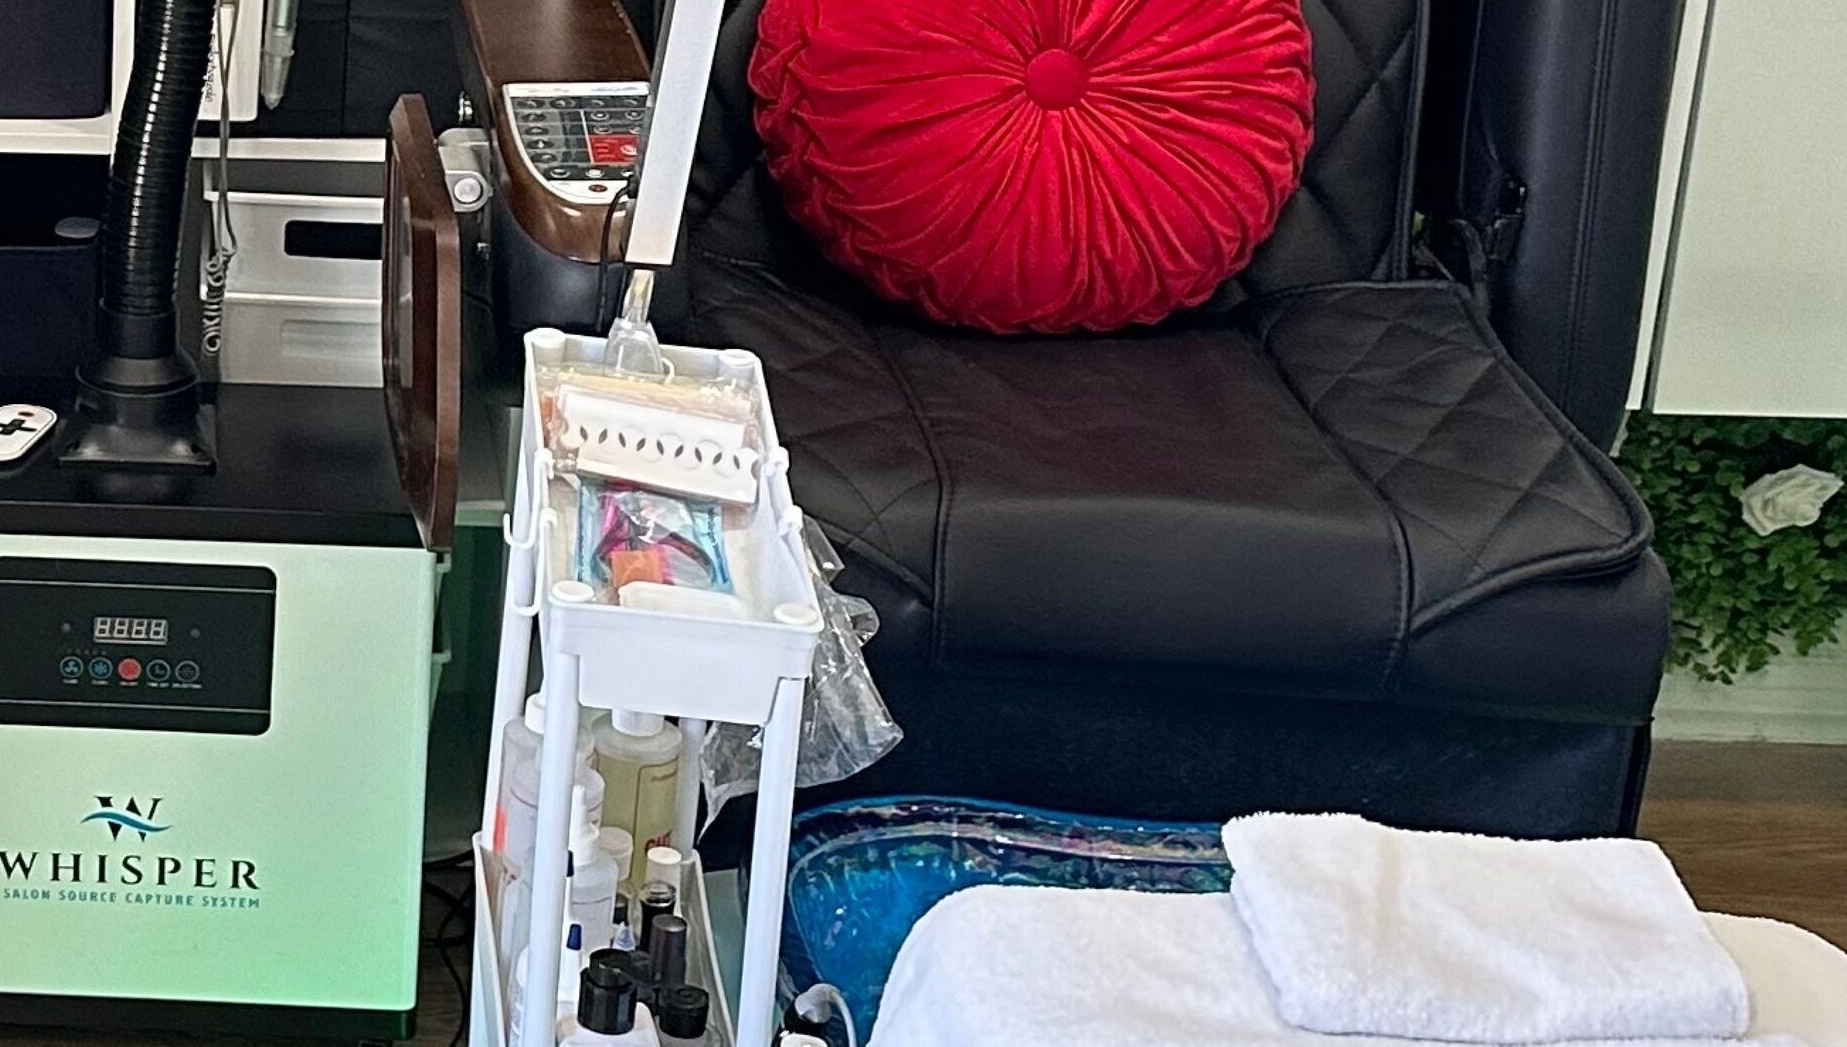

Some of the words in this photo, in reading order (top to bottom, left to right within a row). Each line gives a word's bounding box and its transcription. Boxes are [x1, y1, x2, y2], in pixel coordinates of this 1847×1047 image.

[3, 888, 51, 900] SALON
[58, 890, 117, 903] SOURCE
[125, 892, 194, 906] CAPTURE
[201, 895, 261, 909] SYSTEM
